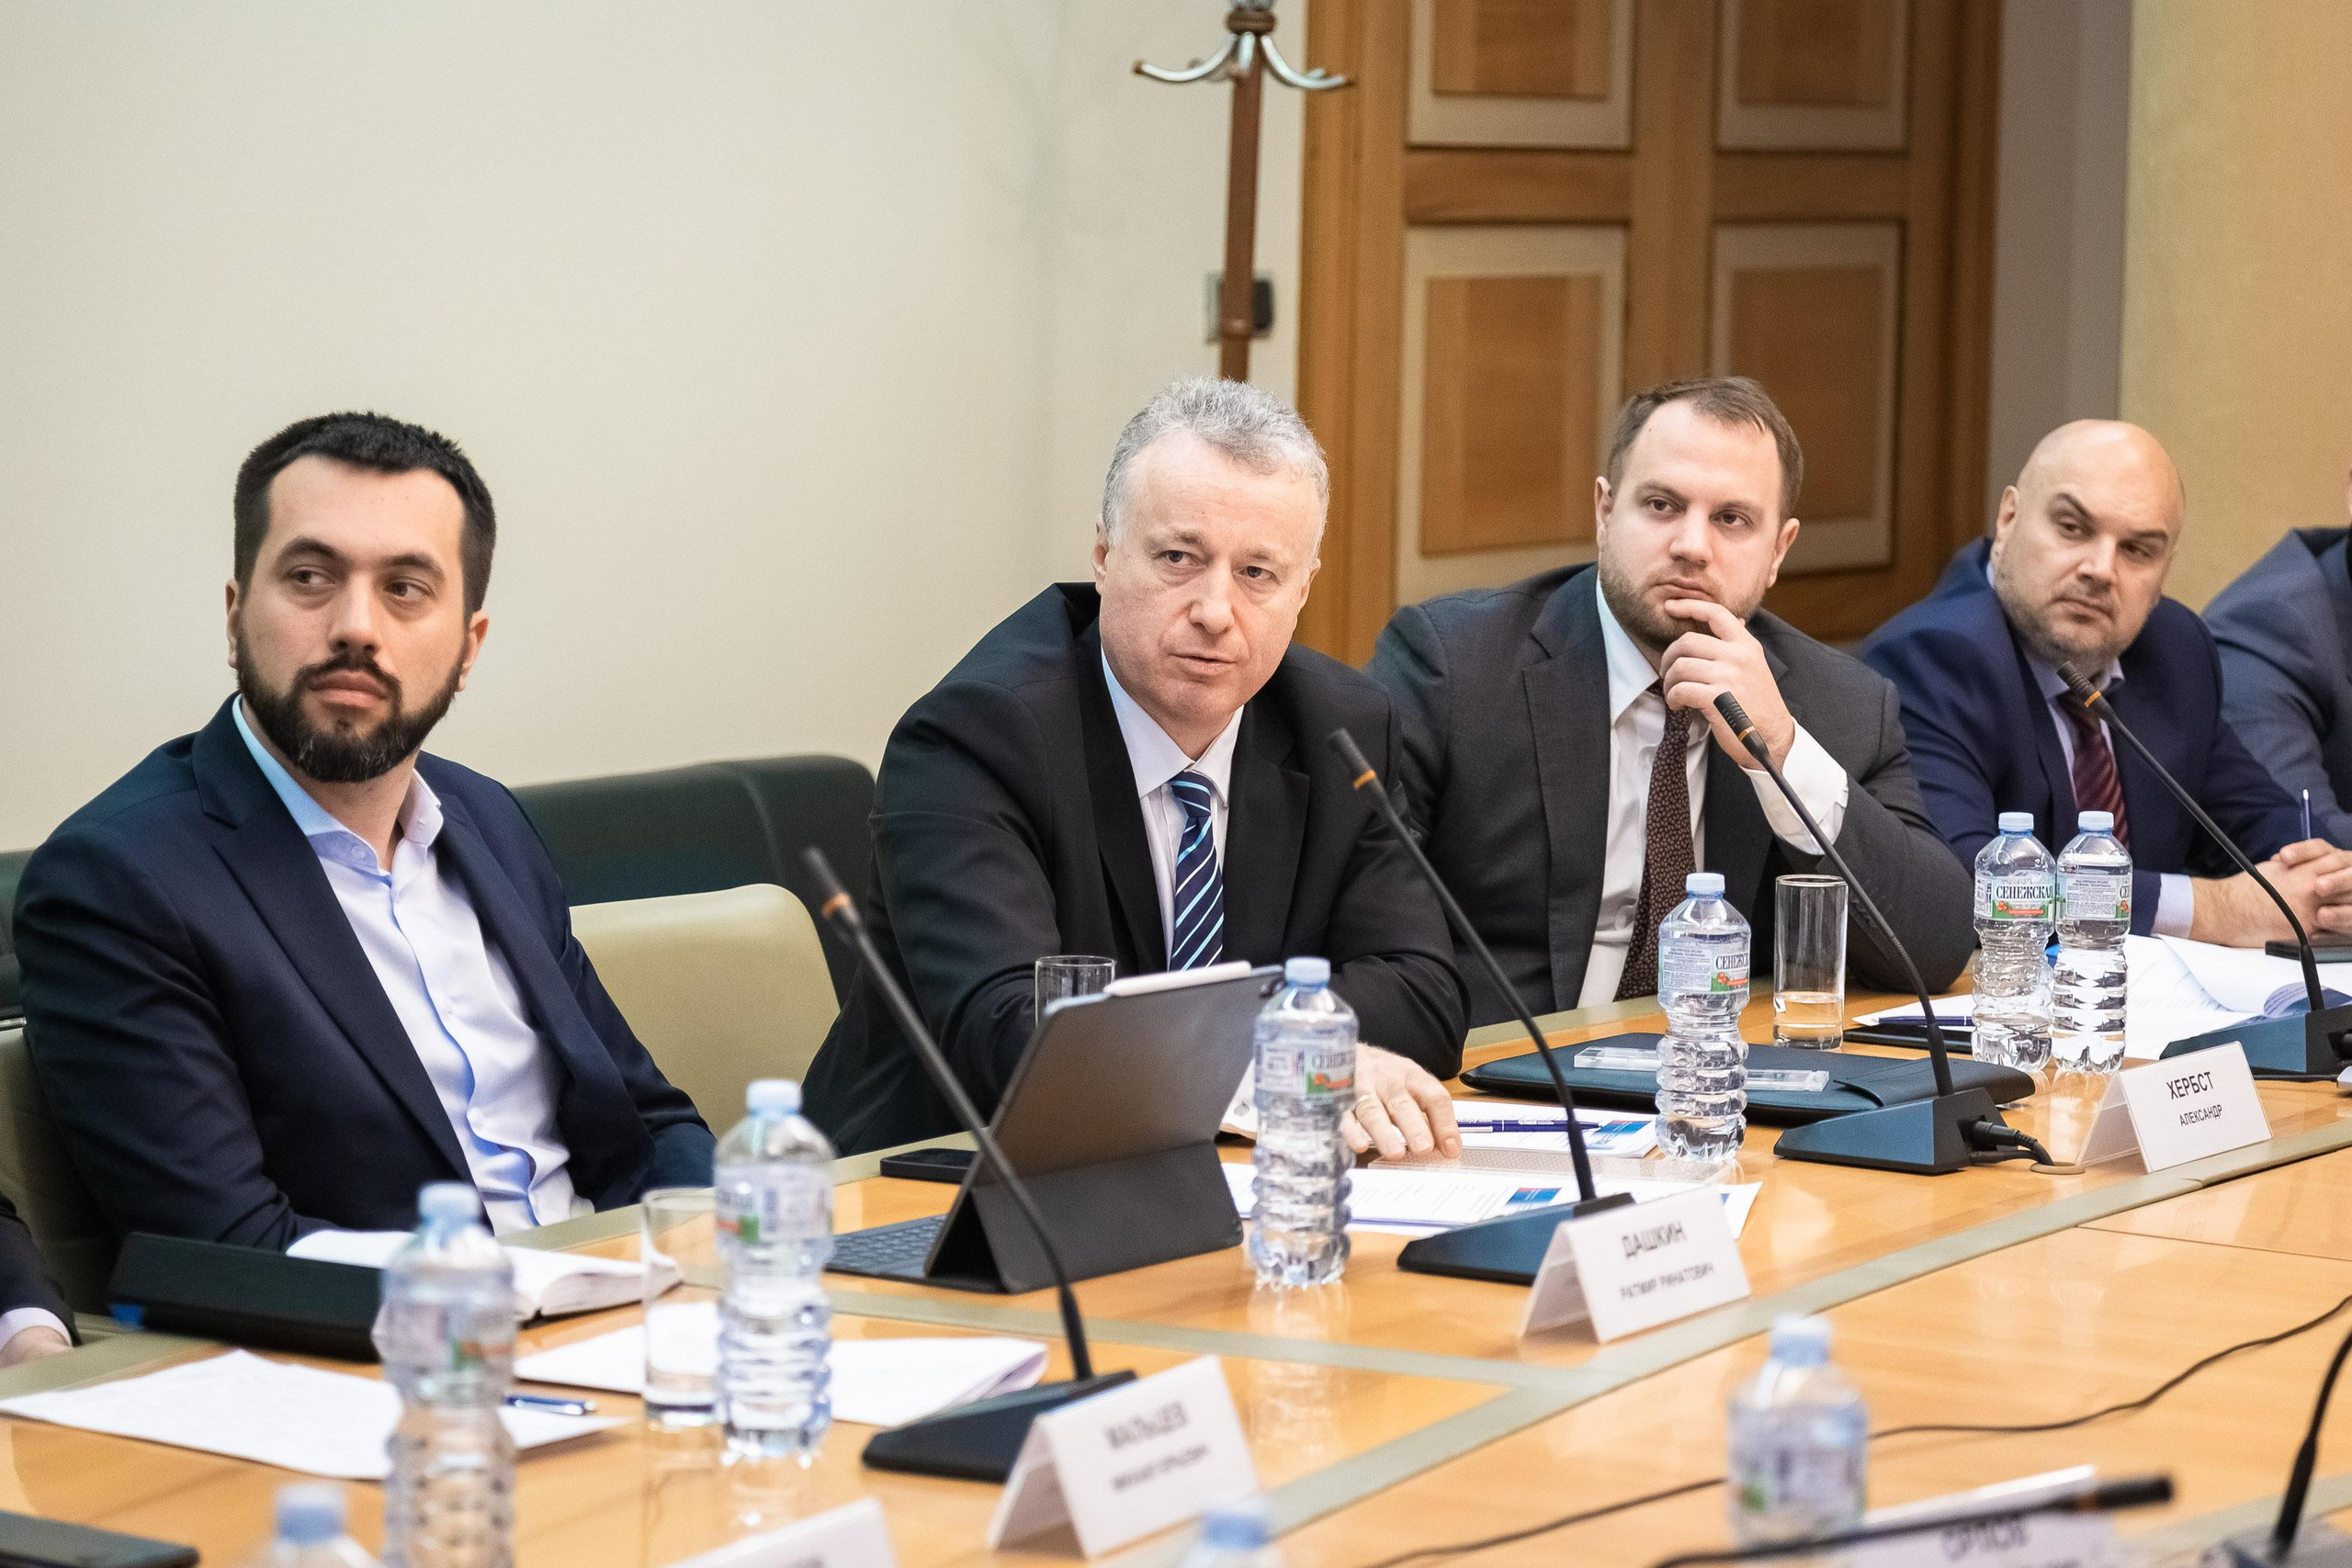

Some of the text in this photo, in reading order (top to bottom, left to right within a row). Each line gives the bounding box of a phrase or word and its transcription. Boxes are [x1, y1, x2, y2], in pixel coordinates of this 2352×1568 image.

[1996, 885, 2054, 899] СЕНЕЖСКАЯ
[2166, 1071, 2214, 1100] ХЕРБСТ
[2179, 1104, 2222, 1126] АЛЕКСАНДР
[1622, 1221, 1686, 1259] ДАШКИН
